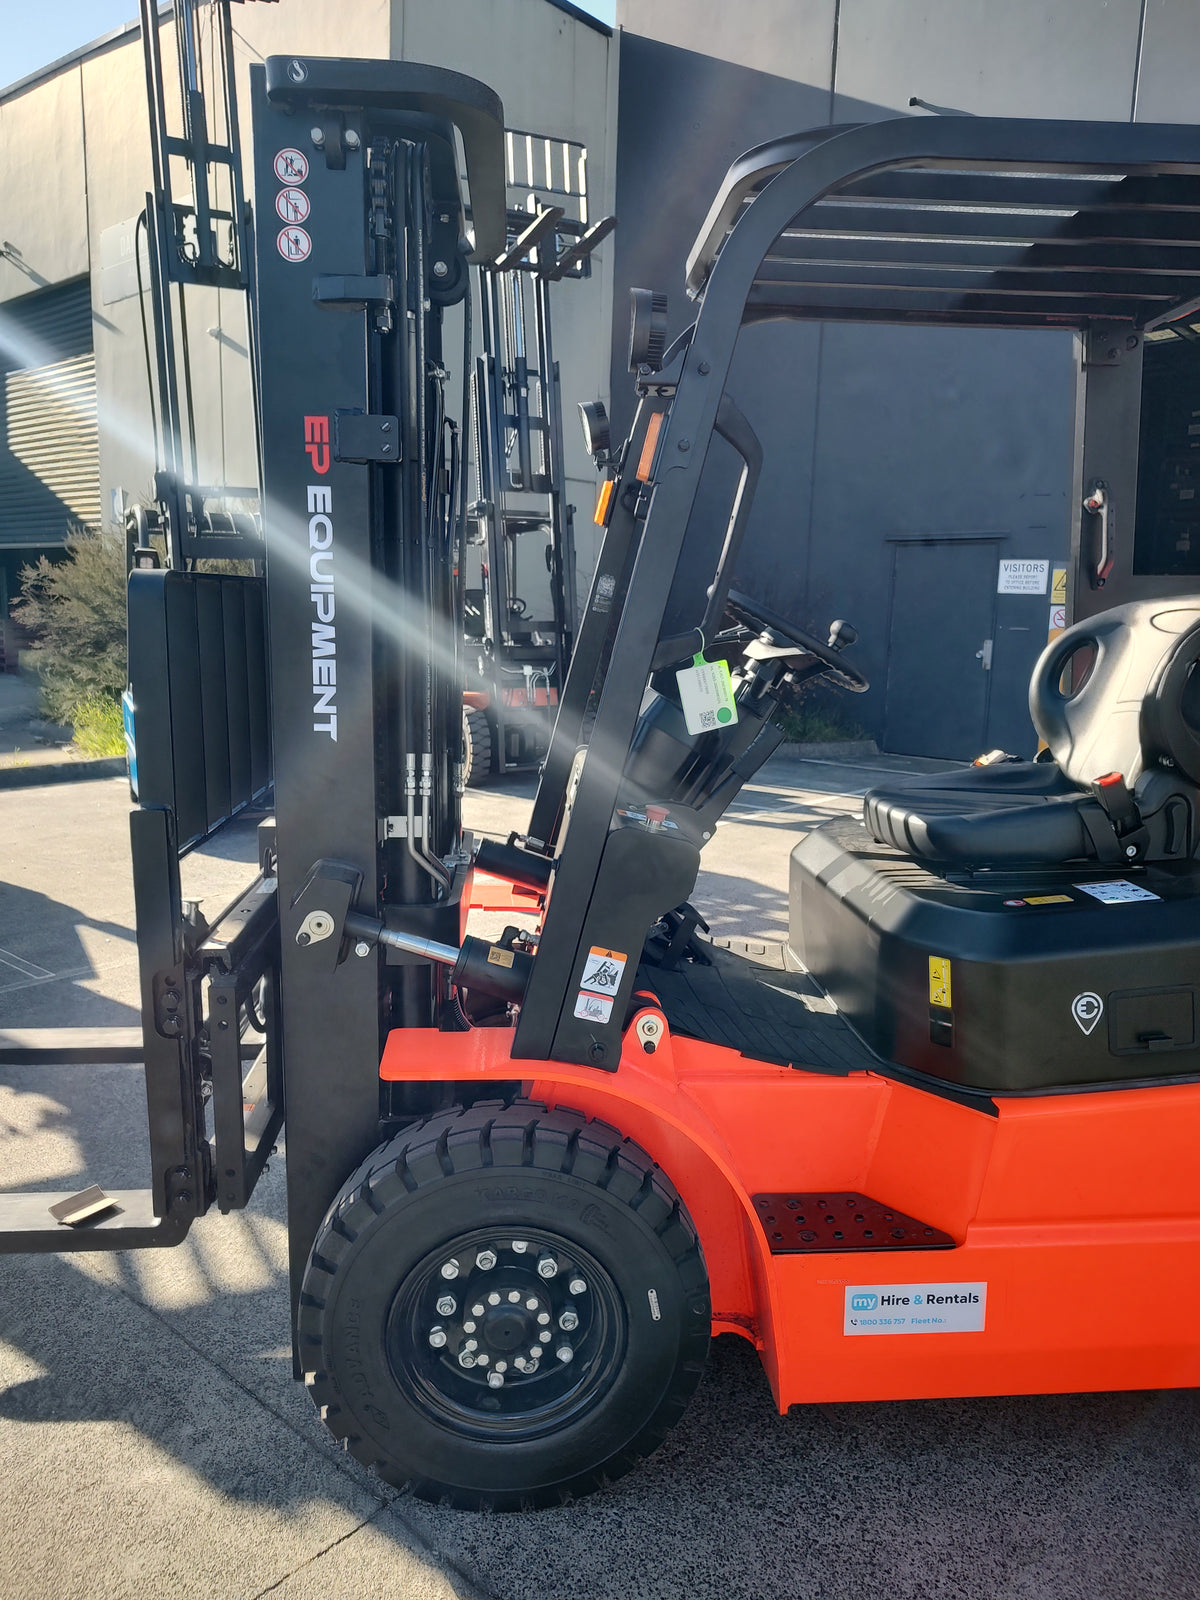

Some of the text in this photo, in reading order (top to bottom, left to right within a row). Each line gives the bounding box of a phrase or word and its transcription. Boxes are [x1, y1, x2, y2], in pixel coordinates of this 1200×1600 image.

[1003, 563, 1045, 573] VISITORS
[304, 415, 338, 743] EP EQUIPMENT
[853, 1293, 979, 1309] my Hire & Rentals
